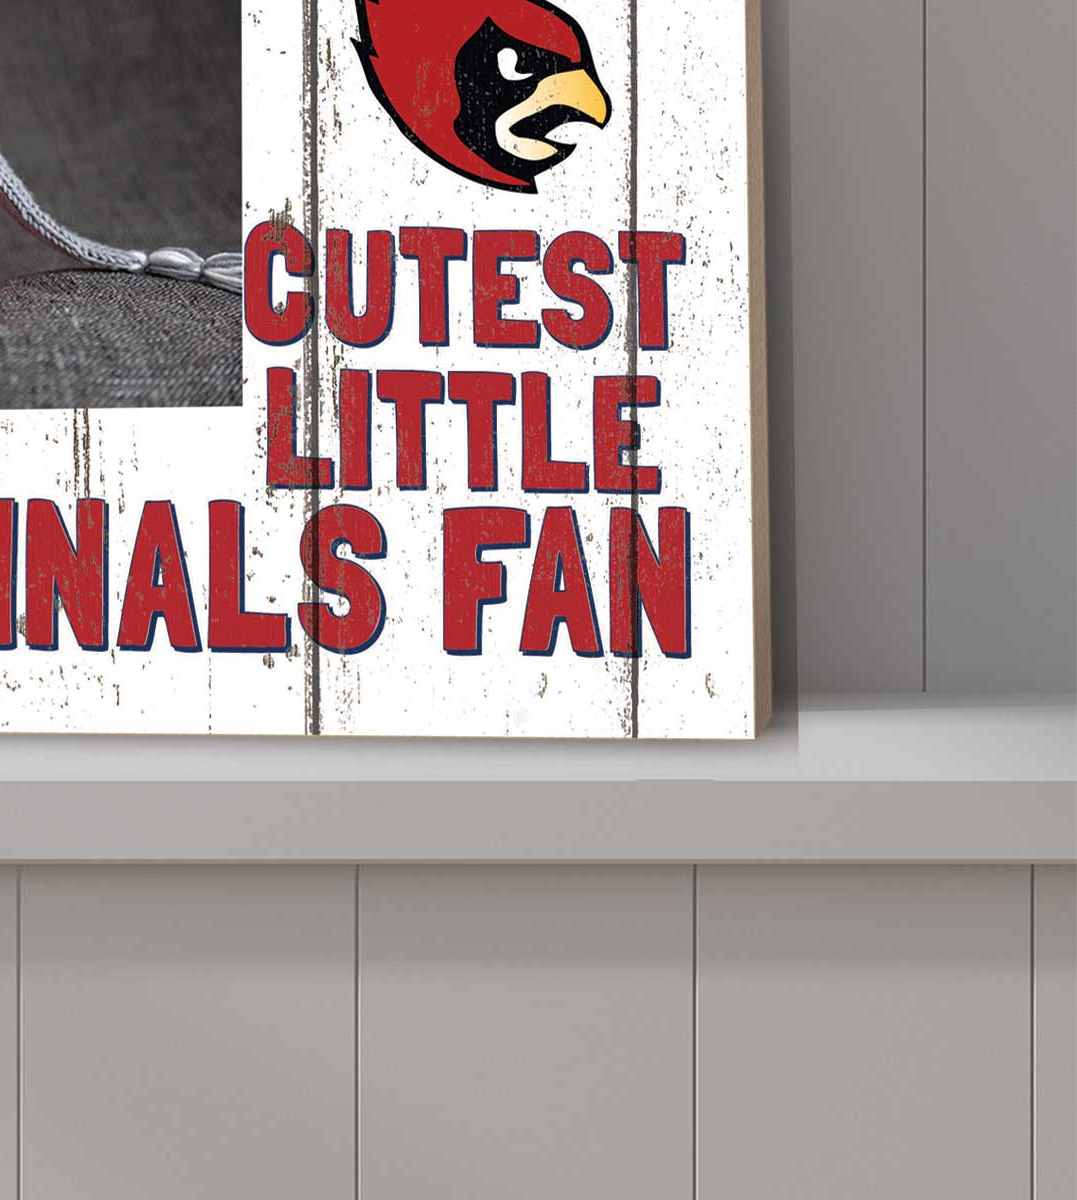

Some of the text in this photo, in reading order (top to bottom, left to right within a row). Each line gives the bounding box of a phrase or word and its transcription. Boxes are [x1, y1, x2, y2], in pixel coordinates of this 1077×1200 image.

[244, 221, 687, 351] CUTEST
[267, 367, 662, 495] LITTLE
[443, 506, 692, 659] FAN
